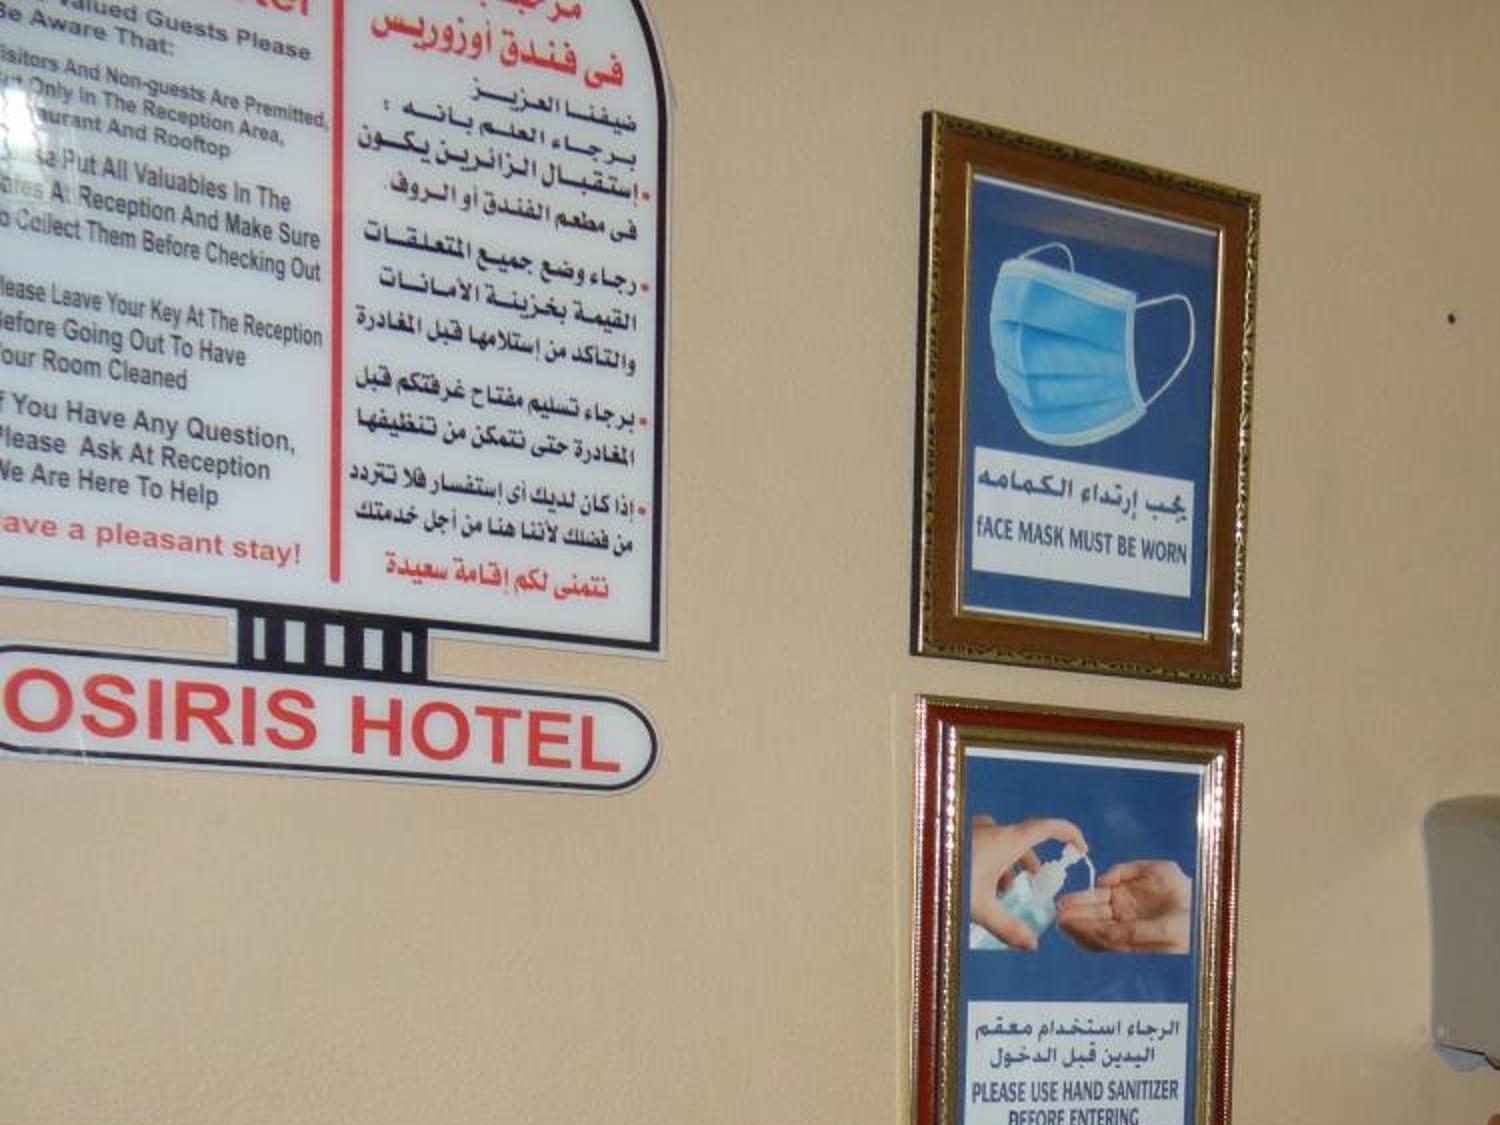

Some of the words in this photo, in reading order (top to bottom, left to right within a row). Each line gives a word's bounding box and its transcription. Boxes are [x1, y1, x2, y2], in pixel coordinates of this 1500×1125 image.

[30, 9, 107, 40] Aware
[115, 26, 175, 56] That:
[62, 0, 138, 22] alued
[146, 8, 228, 42] Guests
[236, 28, 311, 61] Please
[499, 28, 578, 76] فندق
[0, 43, 58, 72] isitors
[64, 58, 100, 81] And
[106, 65, 206, 104] Non-guests
[211, 89, 240, 111] Are
[102, 90, 137, 115] The
[143, 101, 235, 134] Reception
[107, 118, 147, 143] And
[153, 126, 231, 158] Rooftop
[102, 156, 128, 182] All
[133, 161, 227, 200] Valuables
[233, 180, 250, 205] In
[256, 184, 292, 213] The
[79, 184, 176, 222] Reception
[181, 204, 220, 231] And
[225, 210, 273, 242] Make
[278, 221, 321, 250] Sure
[0, 210, 10, 228] o
[86, 219, 136, 249] Them
[142, 228, 200, 261] Before
[205, 241, 286, 280] Checking
[291, 255, 321, 283] Out
[0, 273, 46, 303] lease
[51, 281, 103, 312] Leave
[106, 290, 146, 319] Your
[150, 298, 181, 328] Key
[186, 304, 204, 328] At
[208, 307, 238, 334] The
[243, 313, 323, 347] Reception
[0, 310, 56, 338] efore
[63, 318, 123, 353] Going
[129, 328, 165, 355] Out
[171, 334, 193, 358] To
[200, 339, 247, 367] Have
[0, 341, 36, 368] our
[43, 348, 101, 379] Room
[108, 358, 188, 391] Cleaned
[12, 391, 57, 420] You
[66, 400, 126, 429] Have
[133, 409, 179, 441] Any
[187, 416, 296, 457] Question,
[79, 435, 123, 462] Ask
[129, 442, 155, 466] At
[161, 445, 271, 481] Reception
[31, 462, 71, 489] Are
[78, 468, 130, 495] Here
[137, 474, 163, 499] To
[170, 479, 220, 510] Help
[2, 514, 58, 538] ave
[67, 522, 85, 541] a
[95, 521, 224, 558] pleasant
[232, 538, 302, 568] stay!
[1018, 520, 1064, 548] MASK
[1069, 528, 1113, 555] MUST
[1117, 535, 1137, 558] BE
[1141, 536, 1187, 565] WORN
[2, 666, 318, 753] OSIRIS
[350, 694, 622, 774] HOTEL
[971, 1080, 1027, 1104] PLEASE
[1031, 1081, 1058, 1102] USE
[1063, 1080, 1103, 1101] HAND
[1107, 1079, 1179, 1100] SANITIZER
